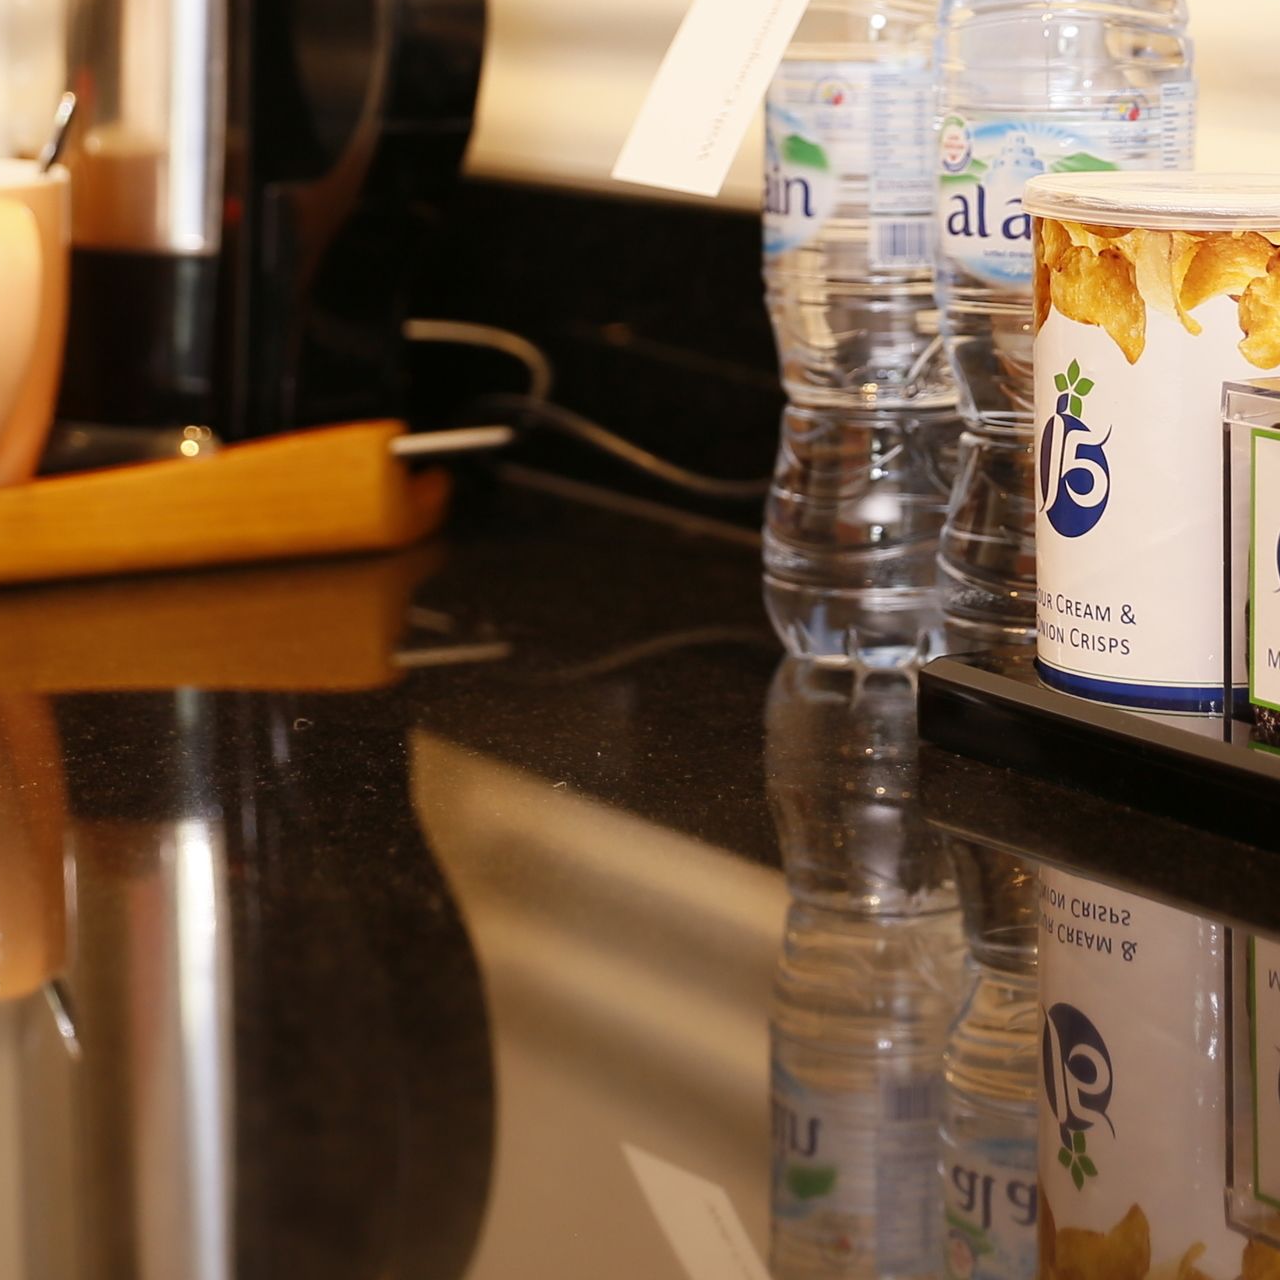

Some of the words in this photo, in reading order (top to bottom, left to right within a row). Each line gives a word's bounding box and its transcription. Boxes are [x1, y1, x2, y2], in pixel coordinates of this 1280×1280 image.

[947, 184, 991, 239] al
[1120, 604, 1136, 625] &
[1070, 627, 1130, 655] CRISPS
